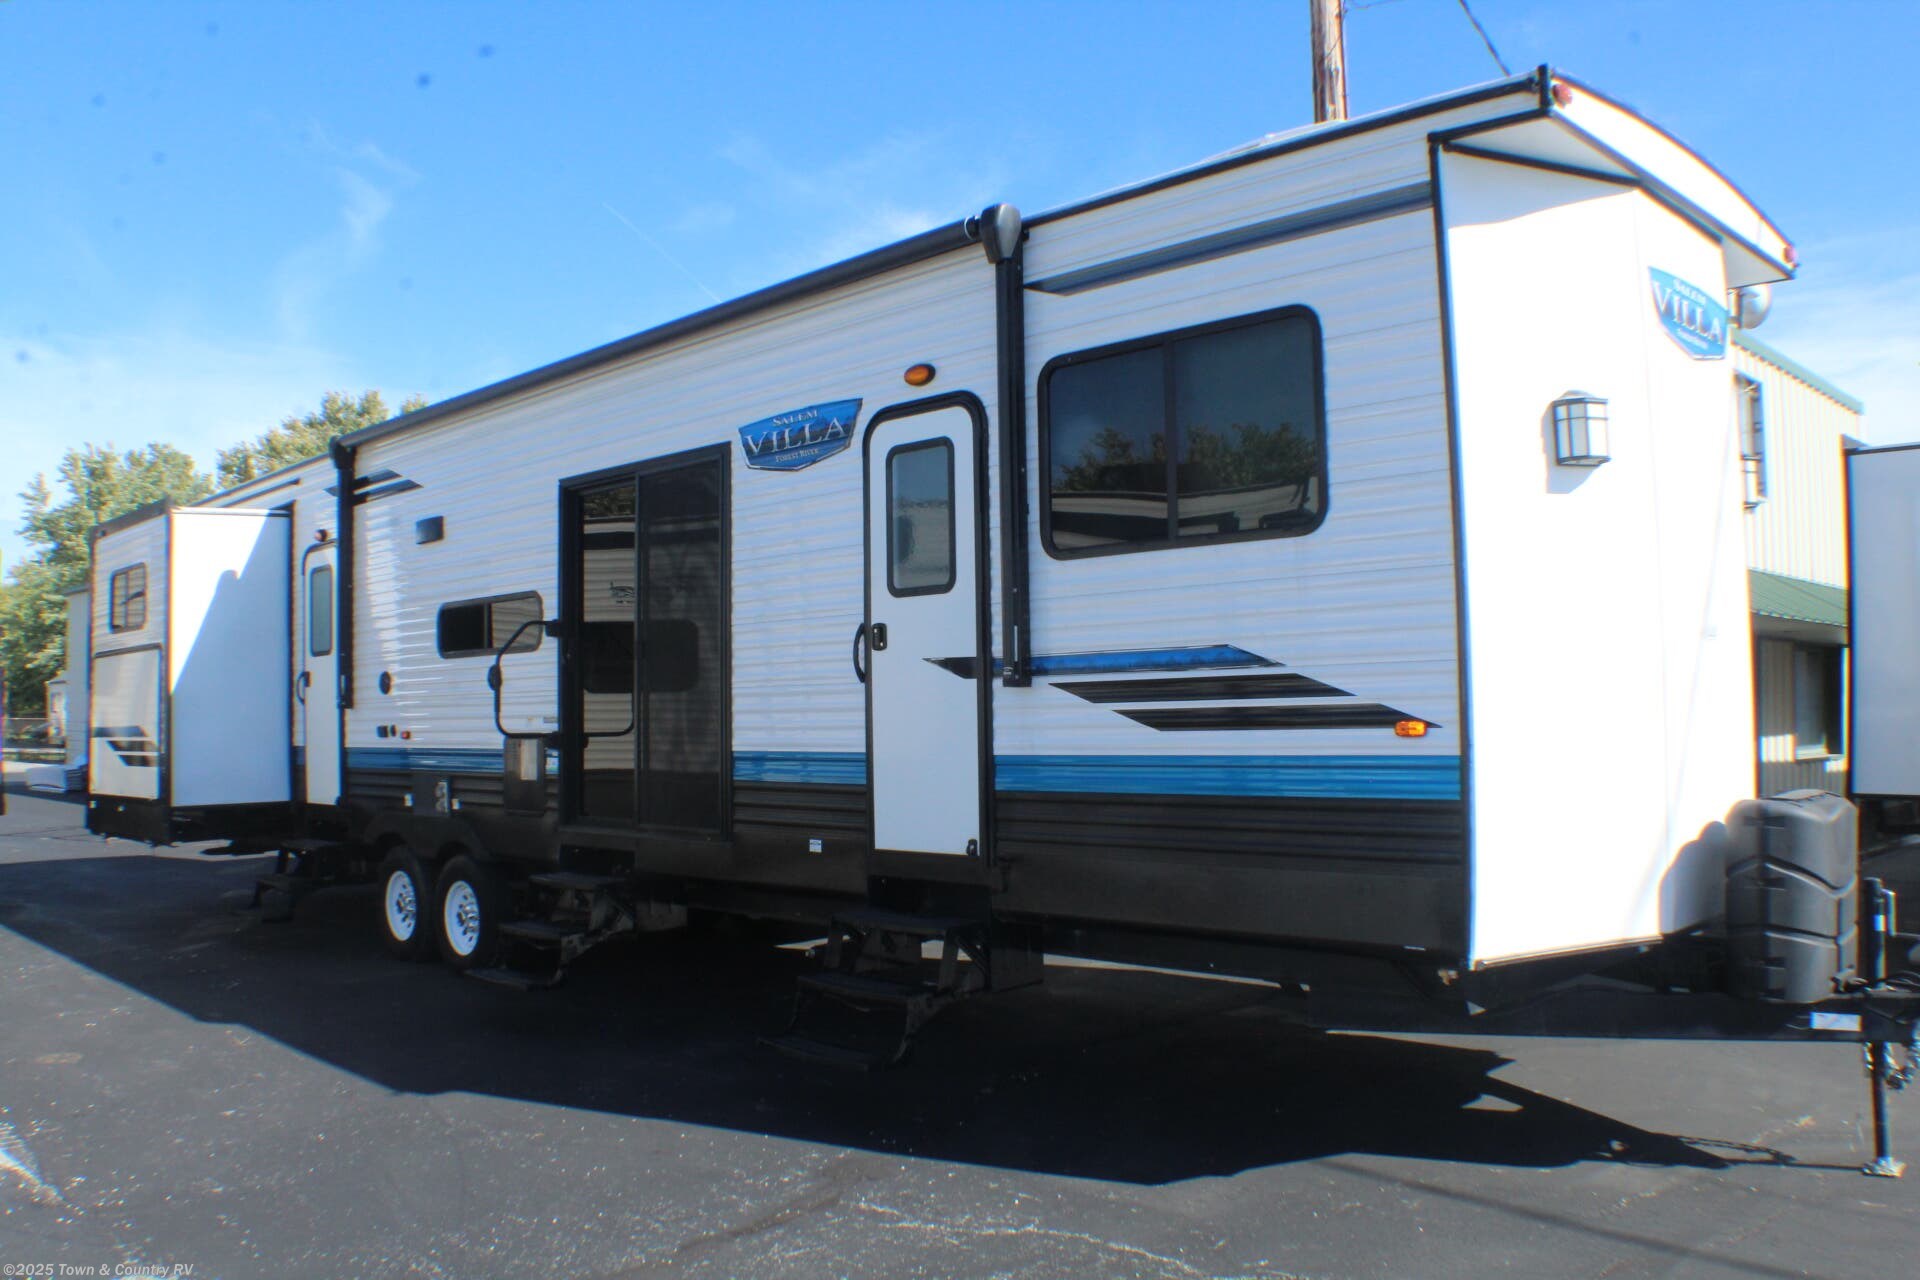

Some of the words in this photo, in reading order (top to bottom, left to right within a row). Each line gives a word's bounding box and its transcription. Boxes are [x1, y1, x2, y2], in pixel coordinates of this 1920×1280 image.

[1652, 282, 1725, 345] VILLA
[744, 417, 848, 455] VILLA
[772, 409, 818, 426] SALEM
